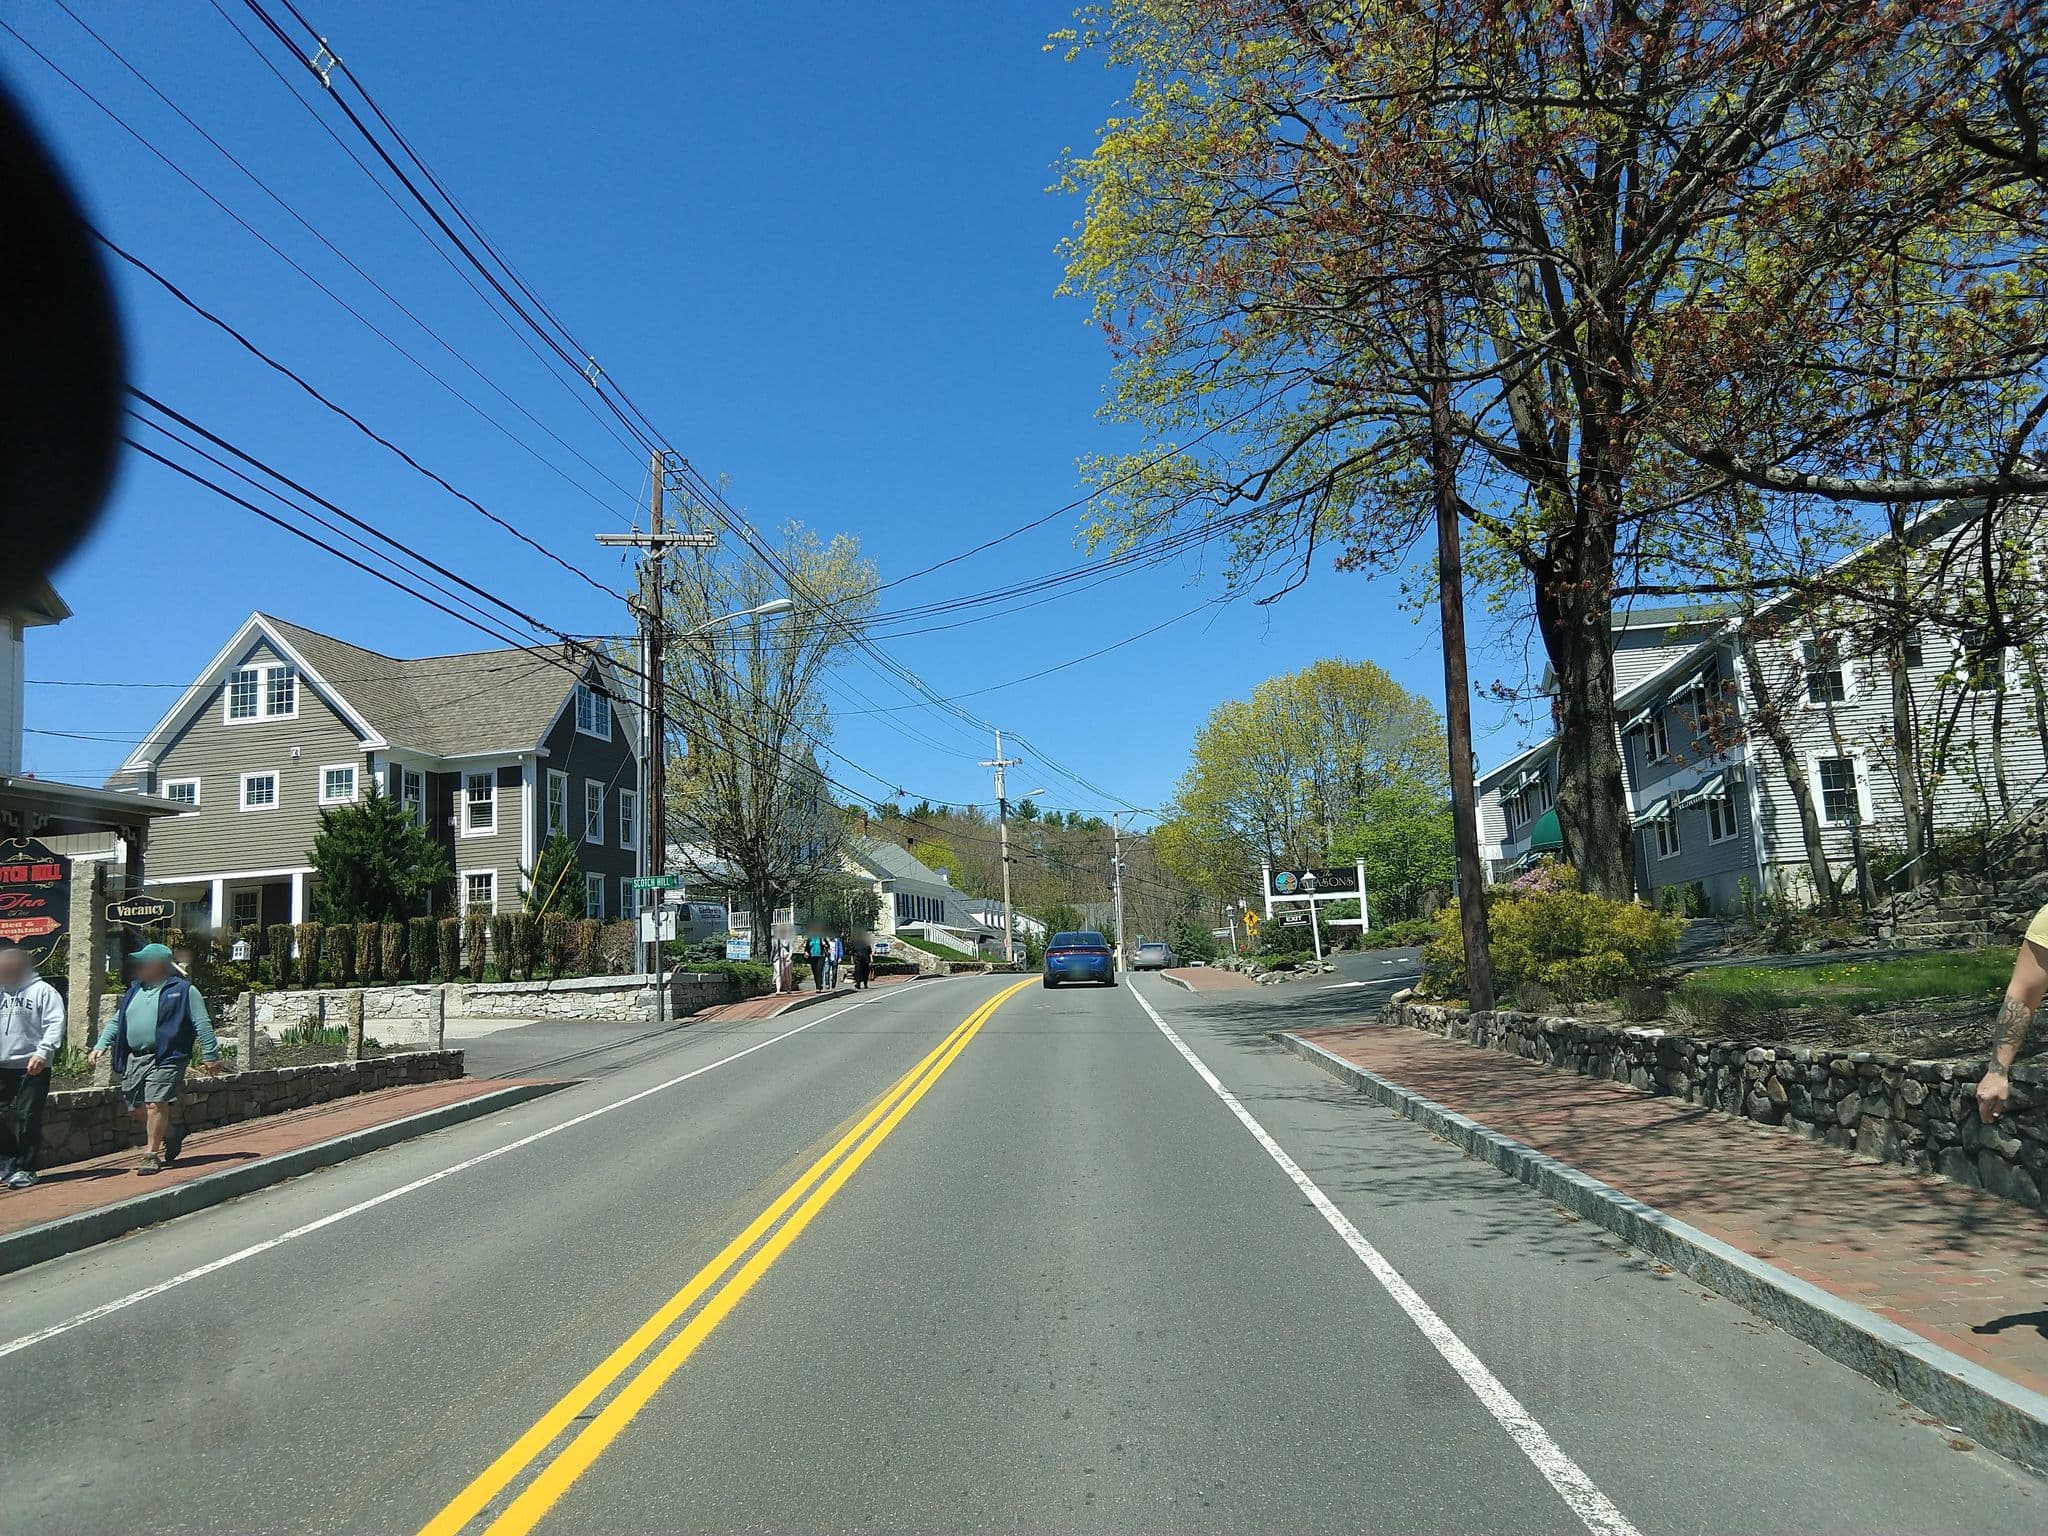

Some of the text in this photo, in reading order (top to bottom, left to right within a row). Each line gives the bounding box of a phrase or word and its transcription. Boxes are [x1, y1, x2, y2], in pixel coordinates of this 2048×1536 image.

[0, 864, 62, 883] TCH HILL
[633, 878, 655, 888] SCOTCH
[656, 877, 670, 887] HILL
[0, 893, 46, 910] Inn
[117, 904, 165, 916] Vacancy
